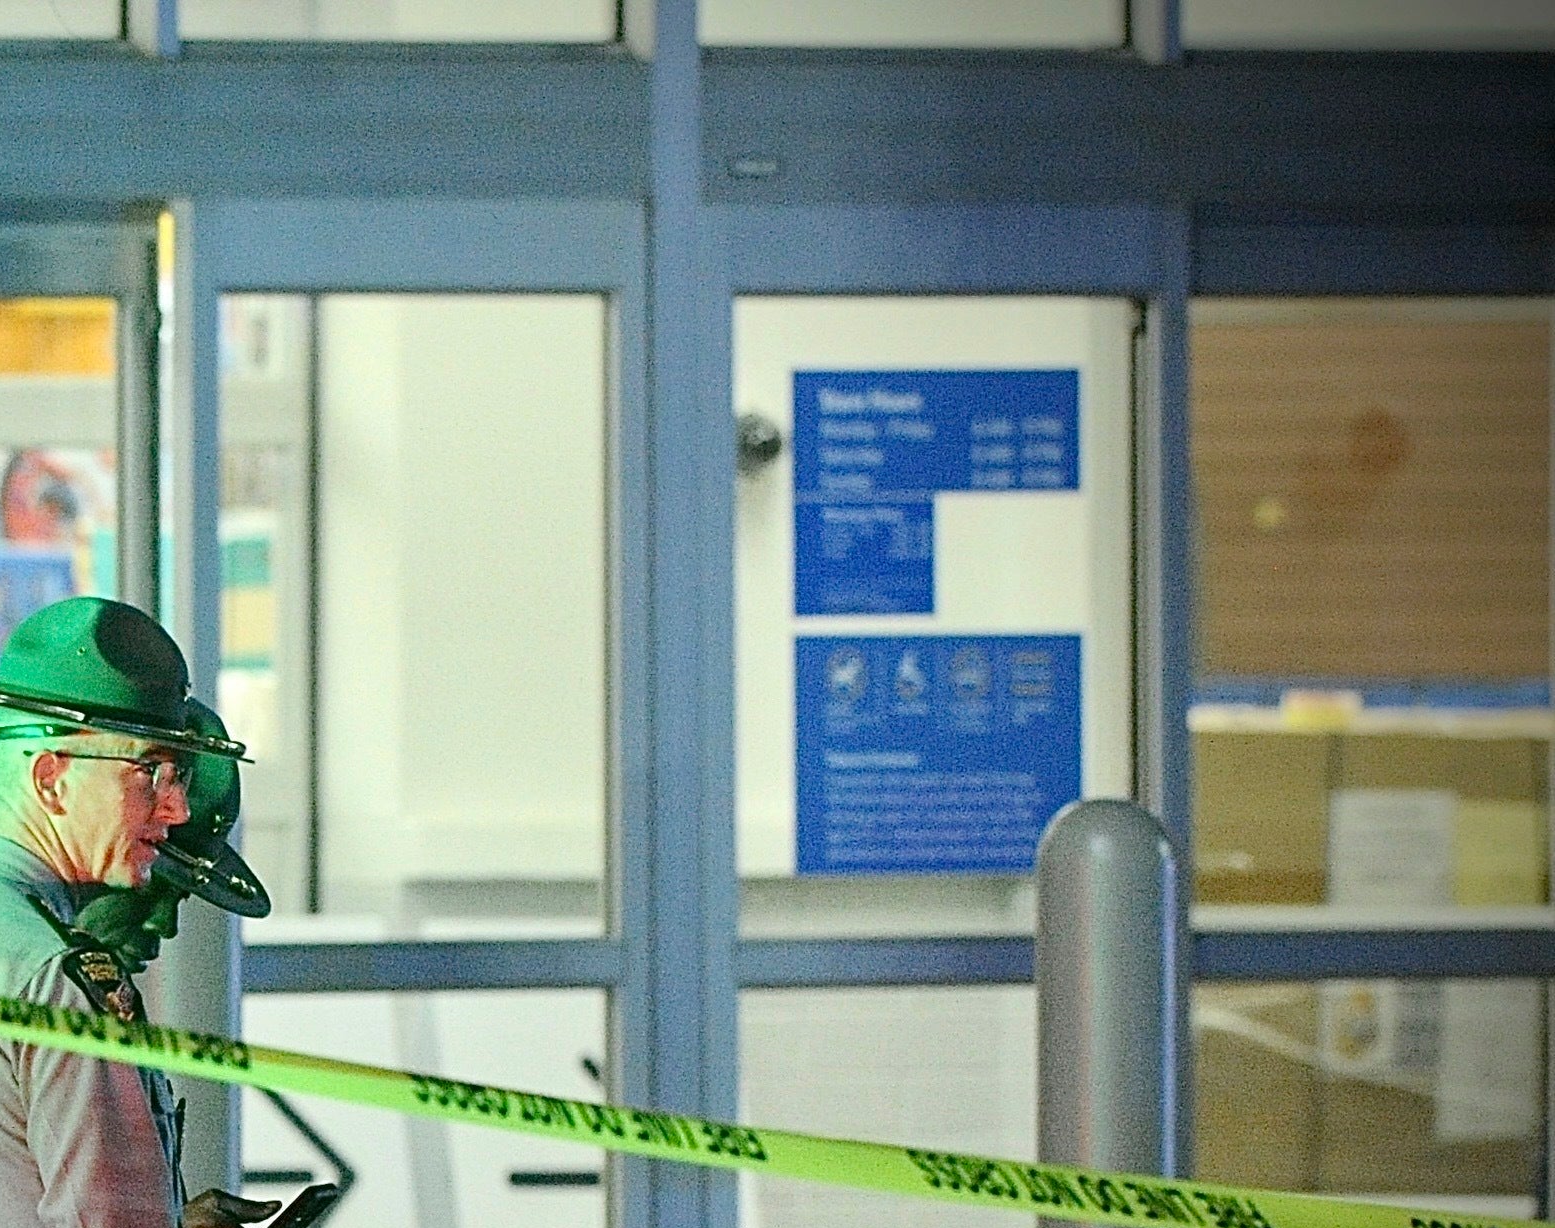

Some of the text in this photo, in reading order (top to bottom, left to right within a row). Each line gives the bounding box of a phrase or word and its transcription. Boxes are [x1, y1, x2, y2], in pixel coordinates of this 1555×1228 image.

[907, 1150, 1018, 1199] CROSS
[1011, 1165, 1085, 1210] NOT
[1076, 1174, 1134, 1218] DO
